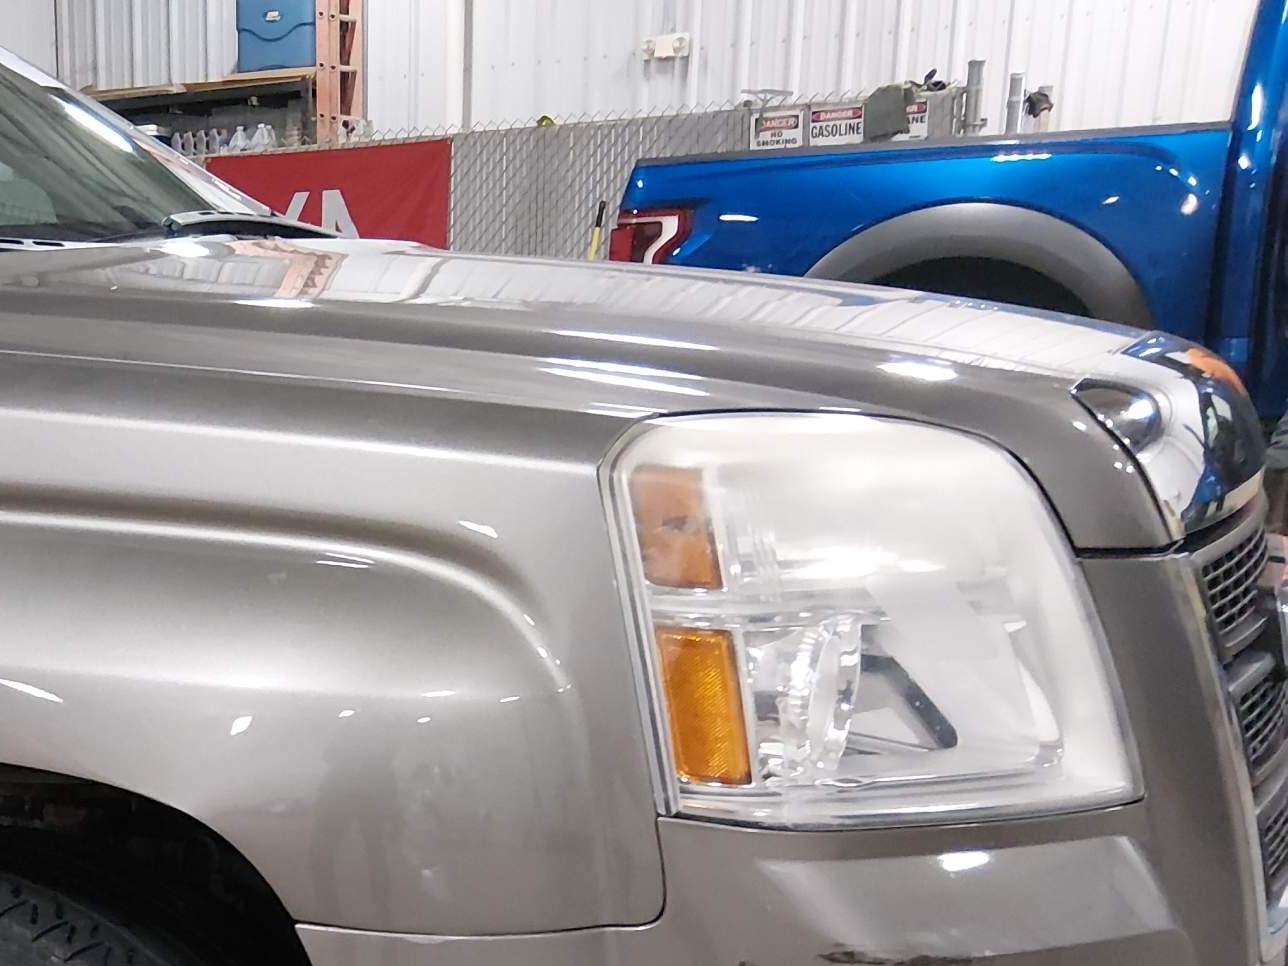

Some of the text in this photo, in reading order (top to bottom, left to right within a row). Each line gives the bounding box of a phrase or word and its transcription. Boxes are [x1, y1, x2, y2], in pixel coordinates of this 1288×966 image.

[820, 109, 853, 121] DANGER
[770, 130, 783, 138] NO
[811, 121, 863, 138] GASOLINE
[756, 137, 798, 147] SMOKING
